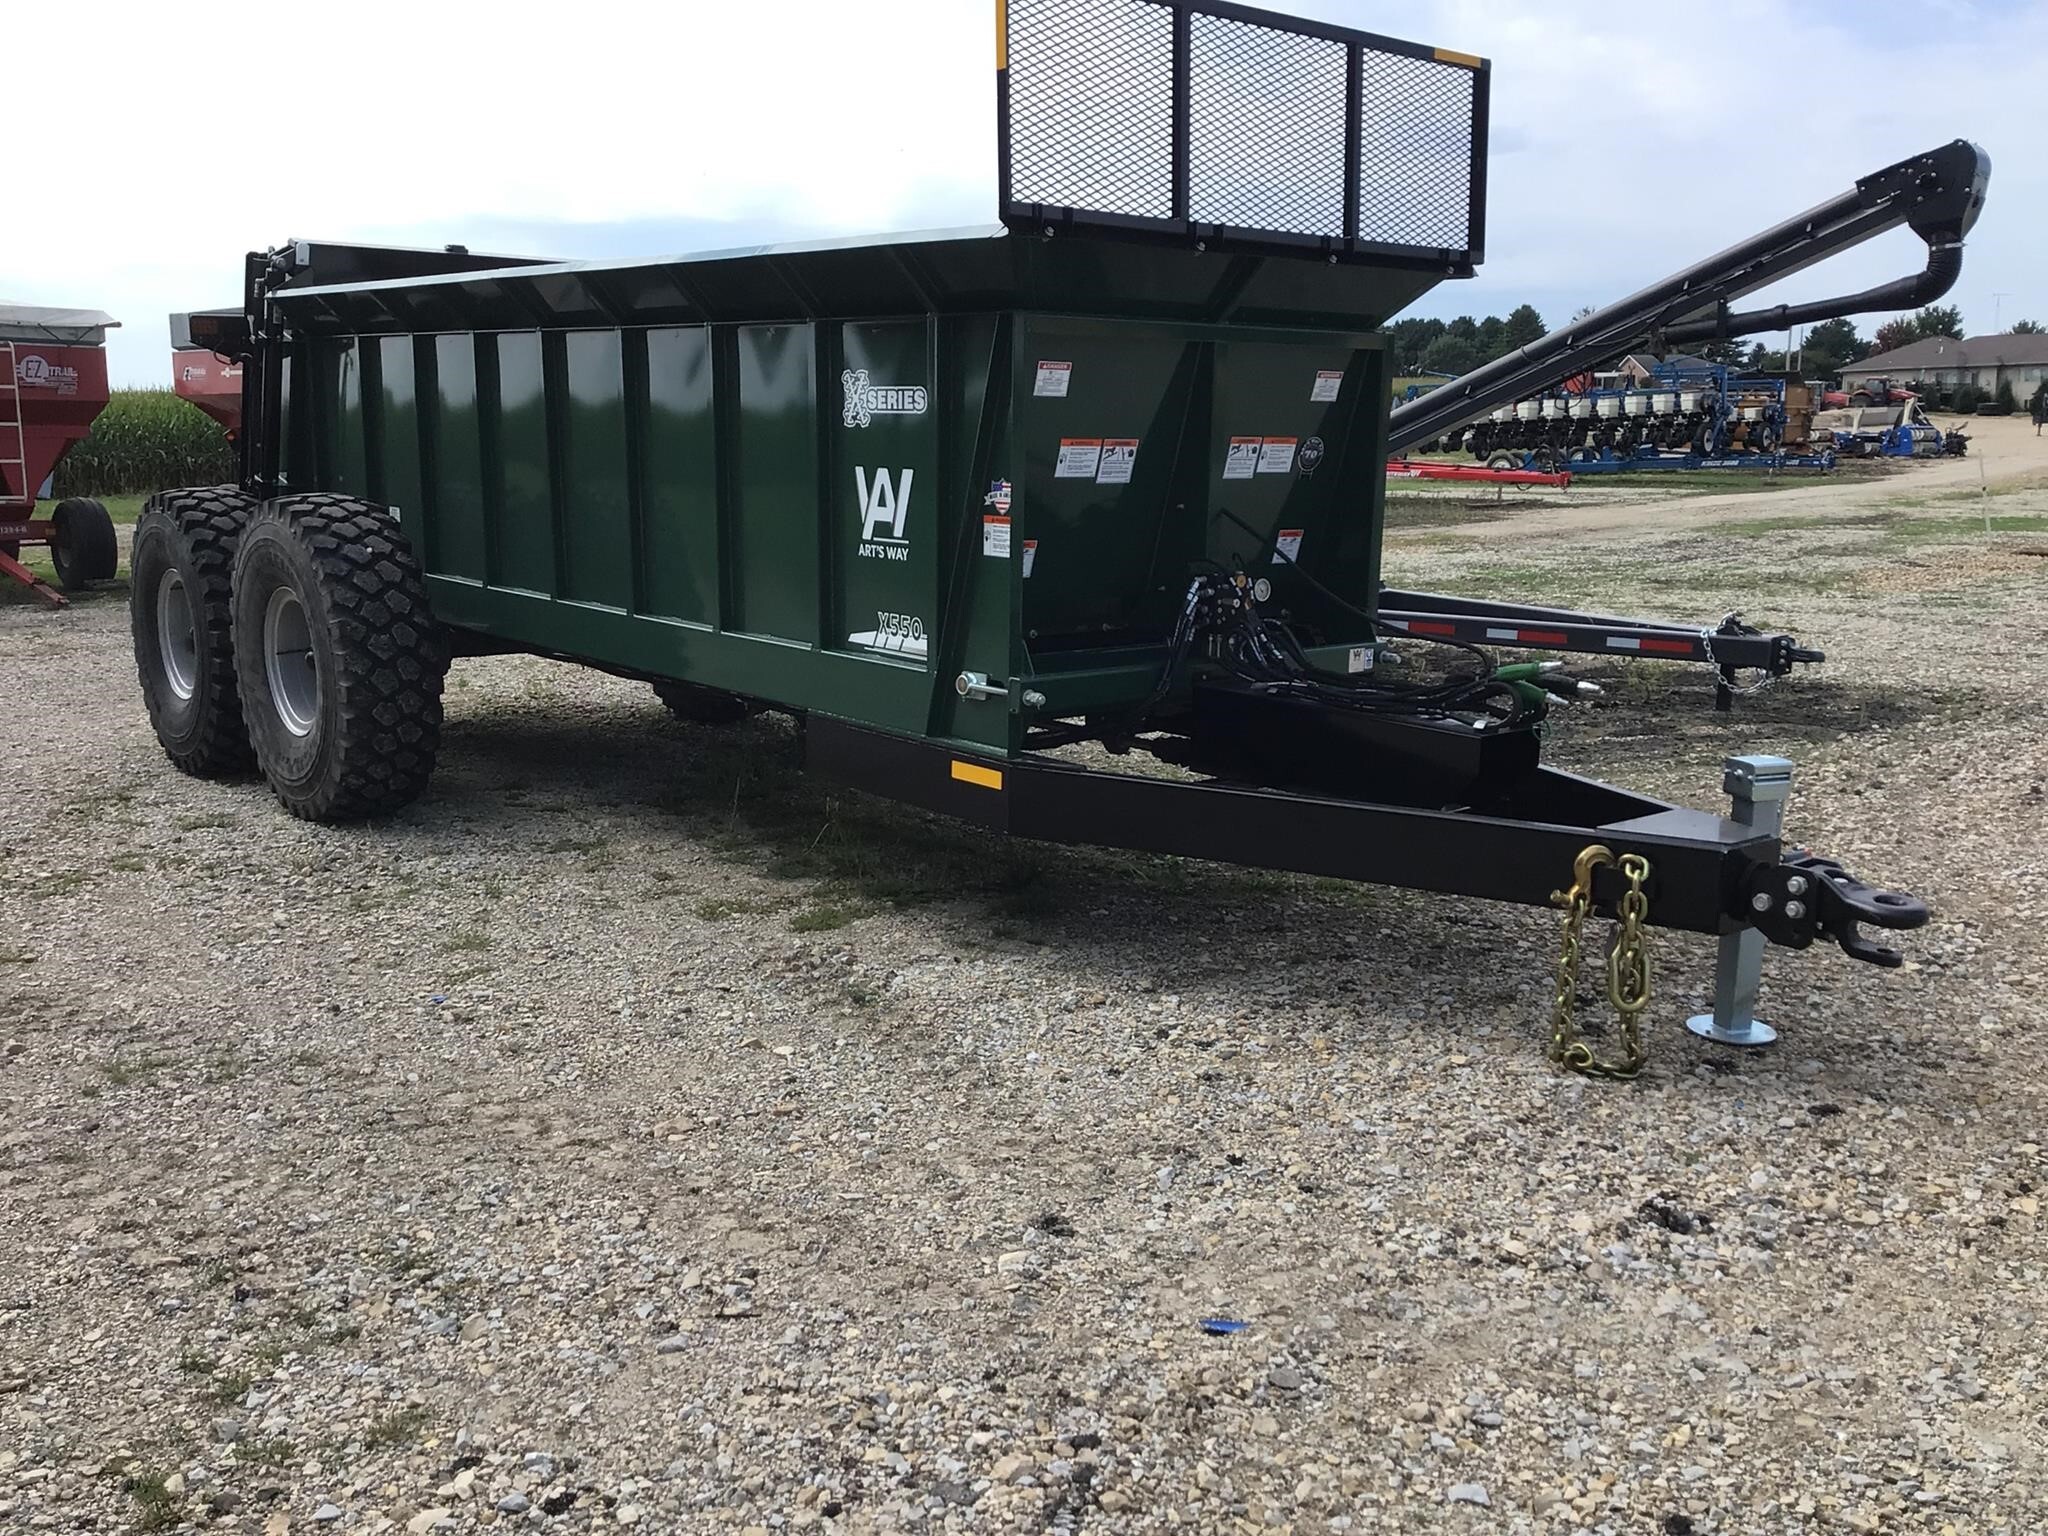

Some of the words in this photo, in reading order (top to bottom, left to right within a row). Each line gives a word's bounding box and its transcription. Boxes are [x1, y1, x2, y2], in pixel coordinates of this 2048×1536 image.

[25, 360, 42, 378] EZ
[867, 390, 925, 410] SERIES
[858, 543, 885, 558] ART'S
[886, 546, 909, 560] WAY
[877, 611, 923, 641] X550
